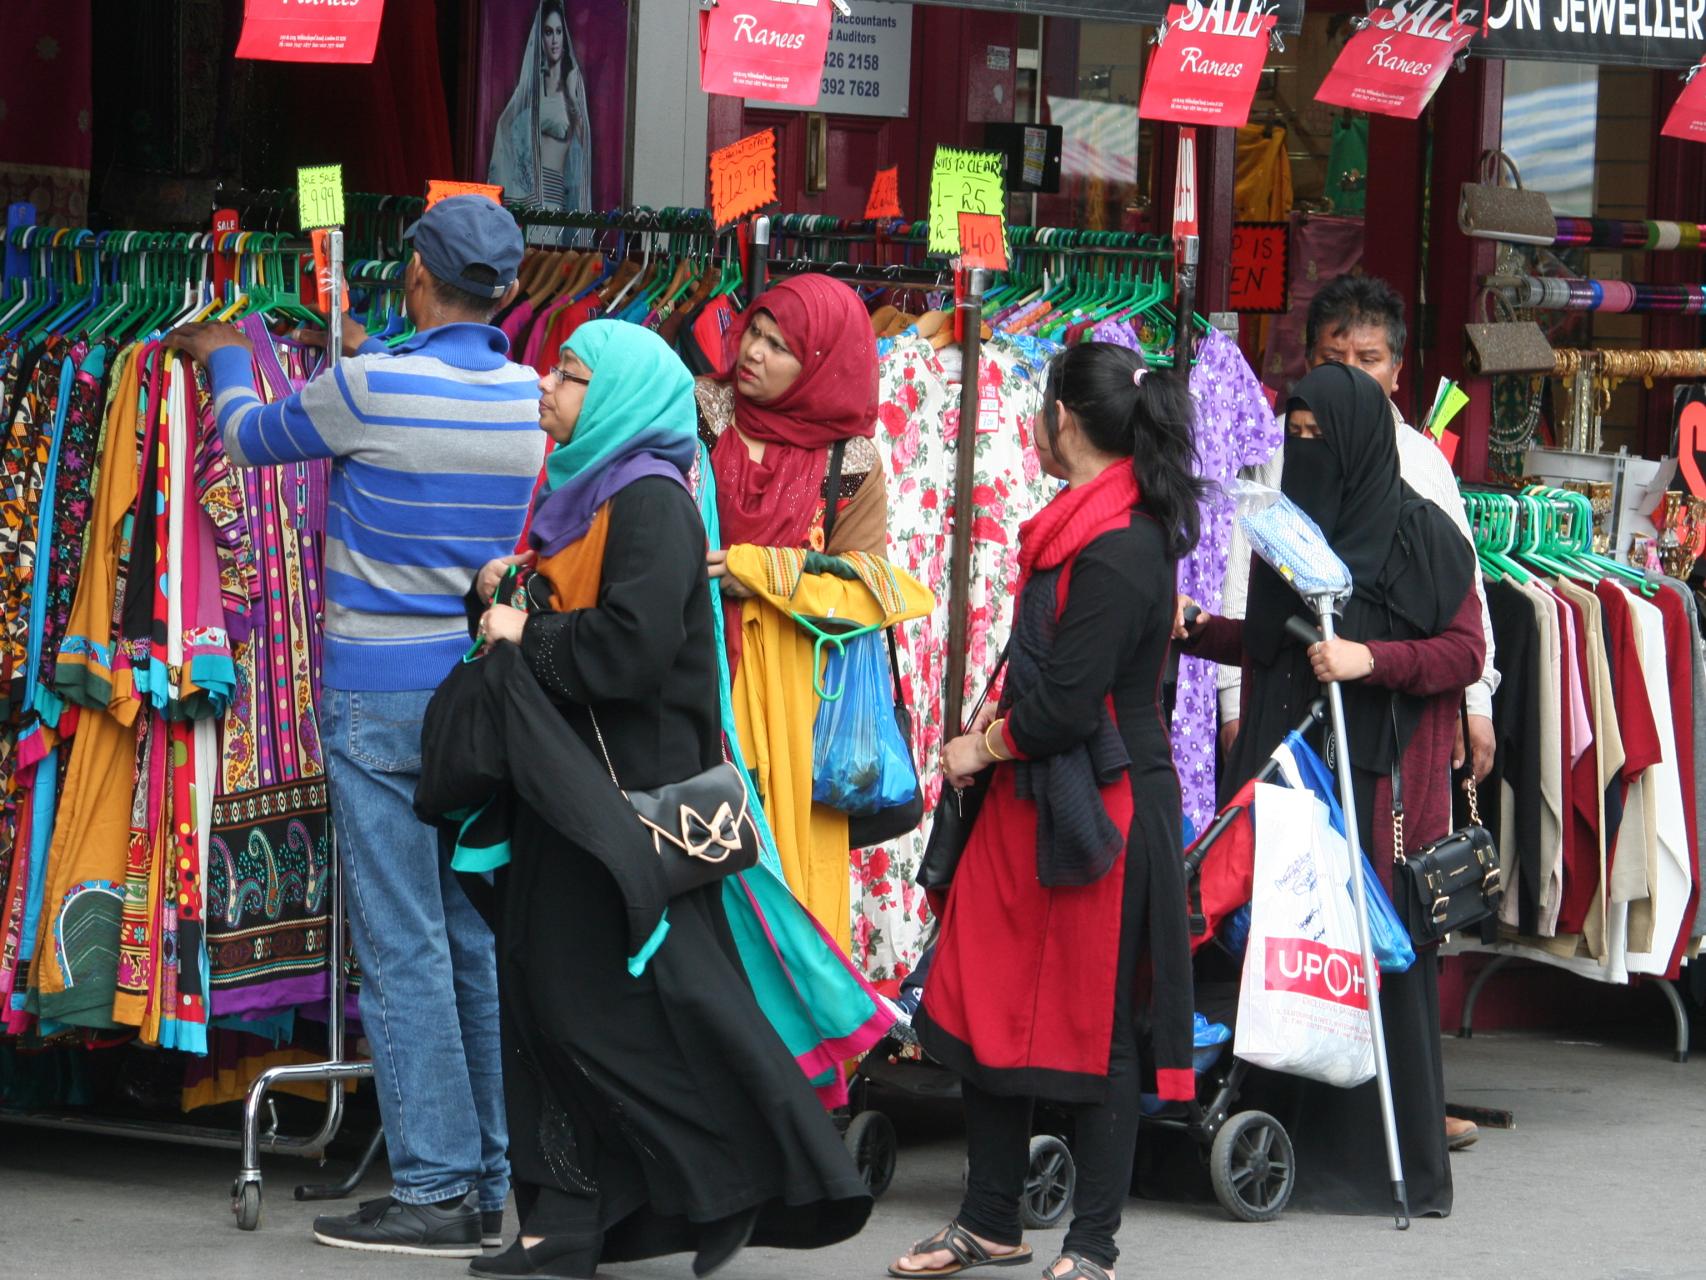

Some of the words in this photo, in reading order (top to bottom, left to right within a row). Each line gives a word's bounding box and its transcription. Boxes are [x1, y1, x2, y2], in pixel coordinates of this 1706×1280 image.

[836, 15, 897, 28] Accountants
[1176, 0, 1267, 38] SALE
[733, 14, 805, 49] Ranees
[836, 30, 876, 44] Auditors
[848, 53, 879, 71] 2158
[1180, 47, 1243, 78] Ranees
[1367, 43, 1433, 76] Ranees
[849, 79, 880, 97] 7628
[967, 160, 999, 178] CLEAR
[216, 219, 235, 232] SALE
[1253, 238, 1273, 260] IS
